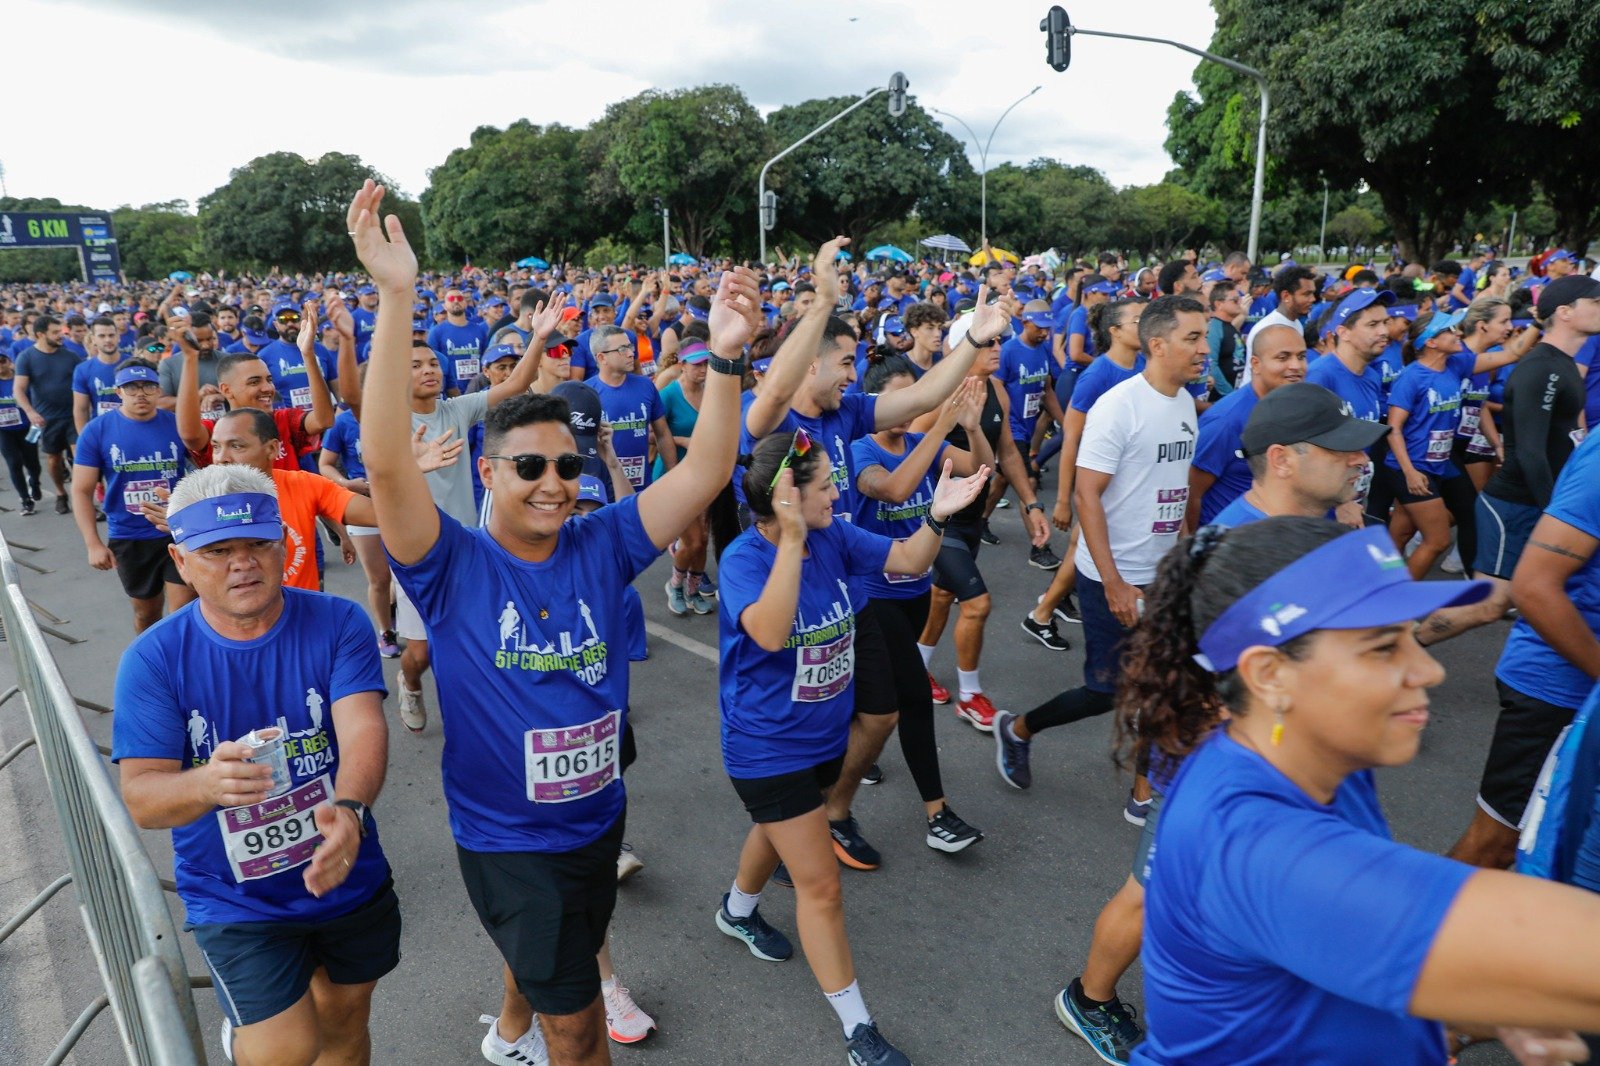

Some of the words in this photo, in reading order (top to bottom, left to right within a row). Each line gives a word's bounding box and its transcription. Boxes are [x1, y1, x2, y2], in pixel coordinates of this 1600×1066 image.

[27, 219, 41, 238] 6
[41, 219, 69, 238] KM
[126, 492, 160, 503] 1105
[804, 652, 851, 684] 10695
[301, 731, 329, 755] REIS
[293, 746, 335, 777] 2024
[536, 739, 615, 780] 10615
[243, 809, 319, 856] 9891
